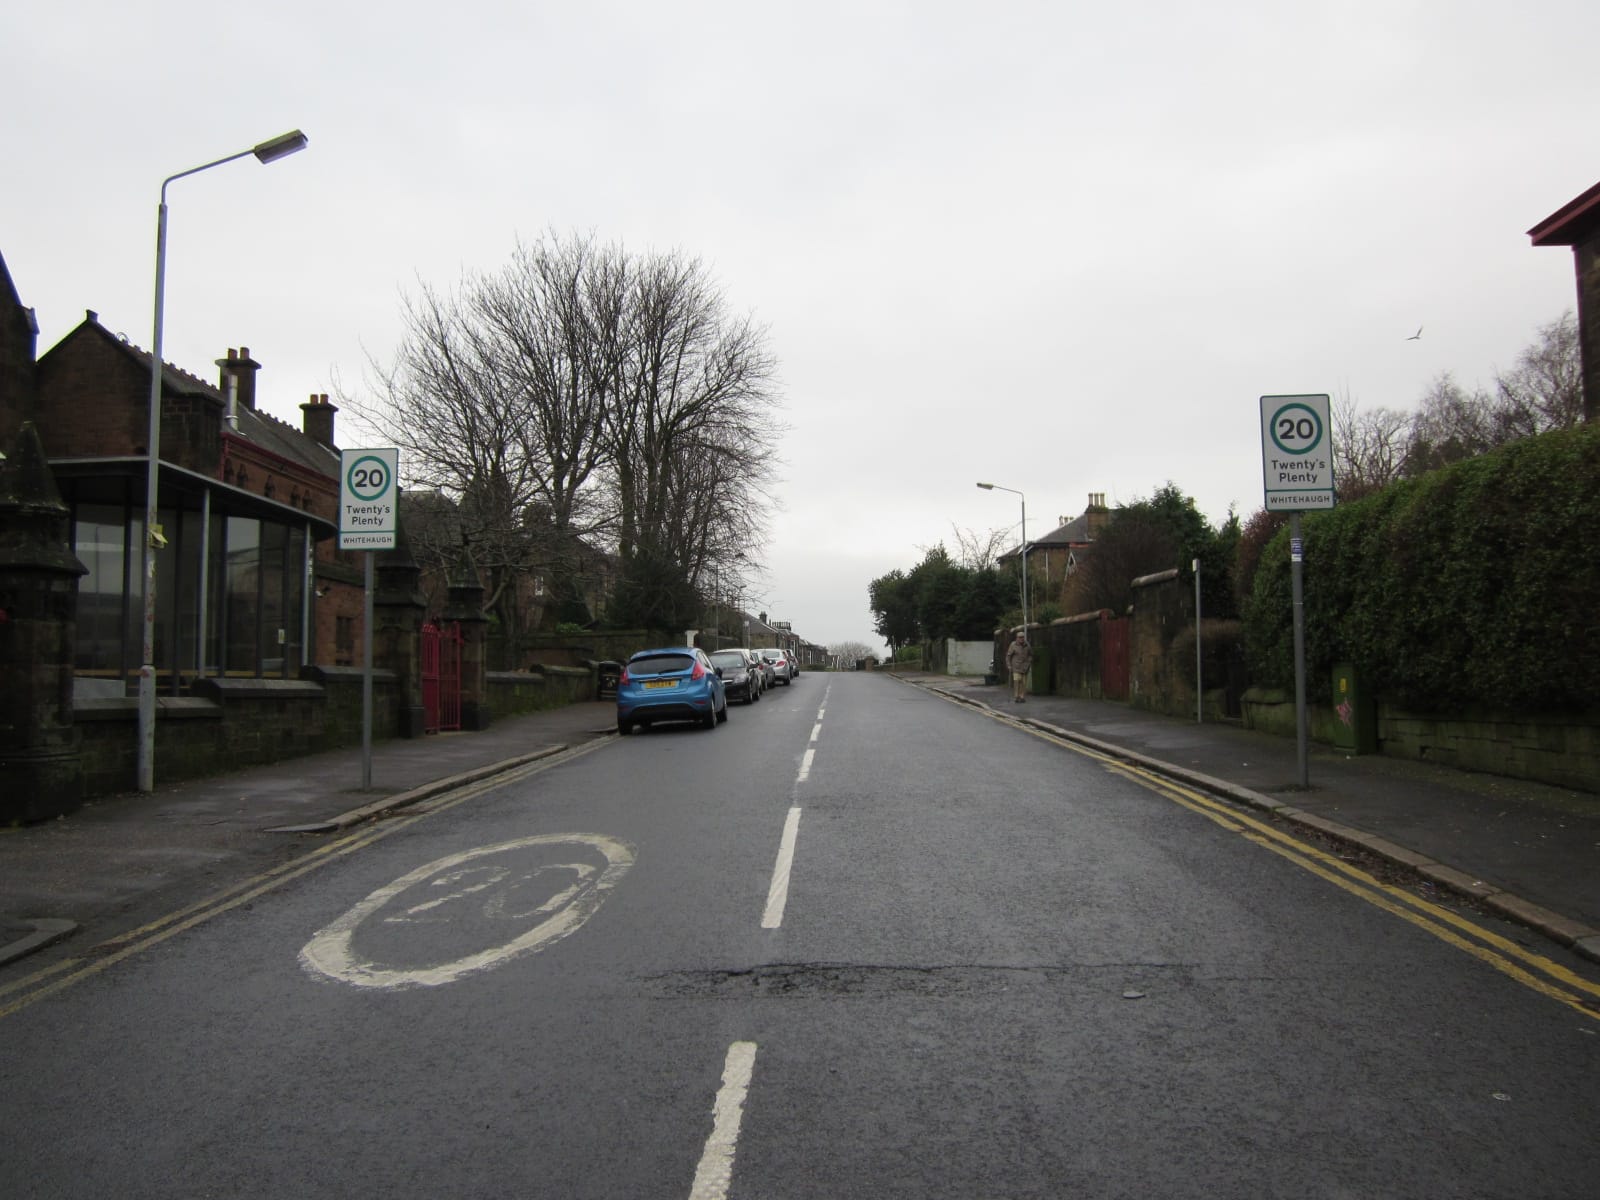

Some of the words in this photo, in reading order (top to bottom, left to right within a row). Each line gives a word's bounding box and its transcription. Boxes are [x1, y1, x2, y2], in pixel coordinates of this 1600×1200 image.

[1279, 418, 1314, 439] 20
[1271, 459, 1325, 471] Twenty's
[354, 469, 384, 488] 20
[1279, 472, 1318, 483] Plenty
[1270, 495, 1330, 504] WHITEHAUGH
[346, 505, 390, 515] Twenty's
[352, 516, 384, 526] Plenty
